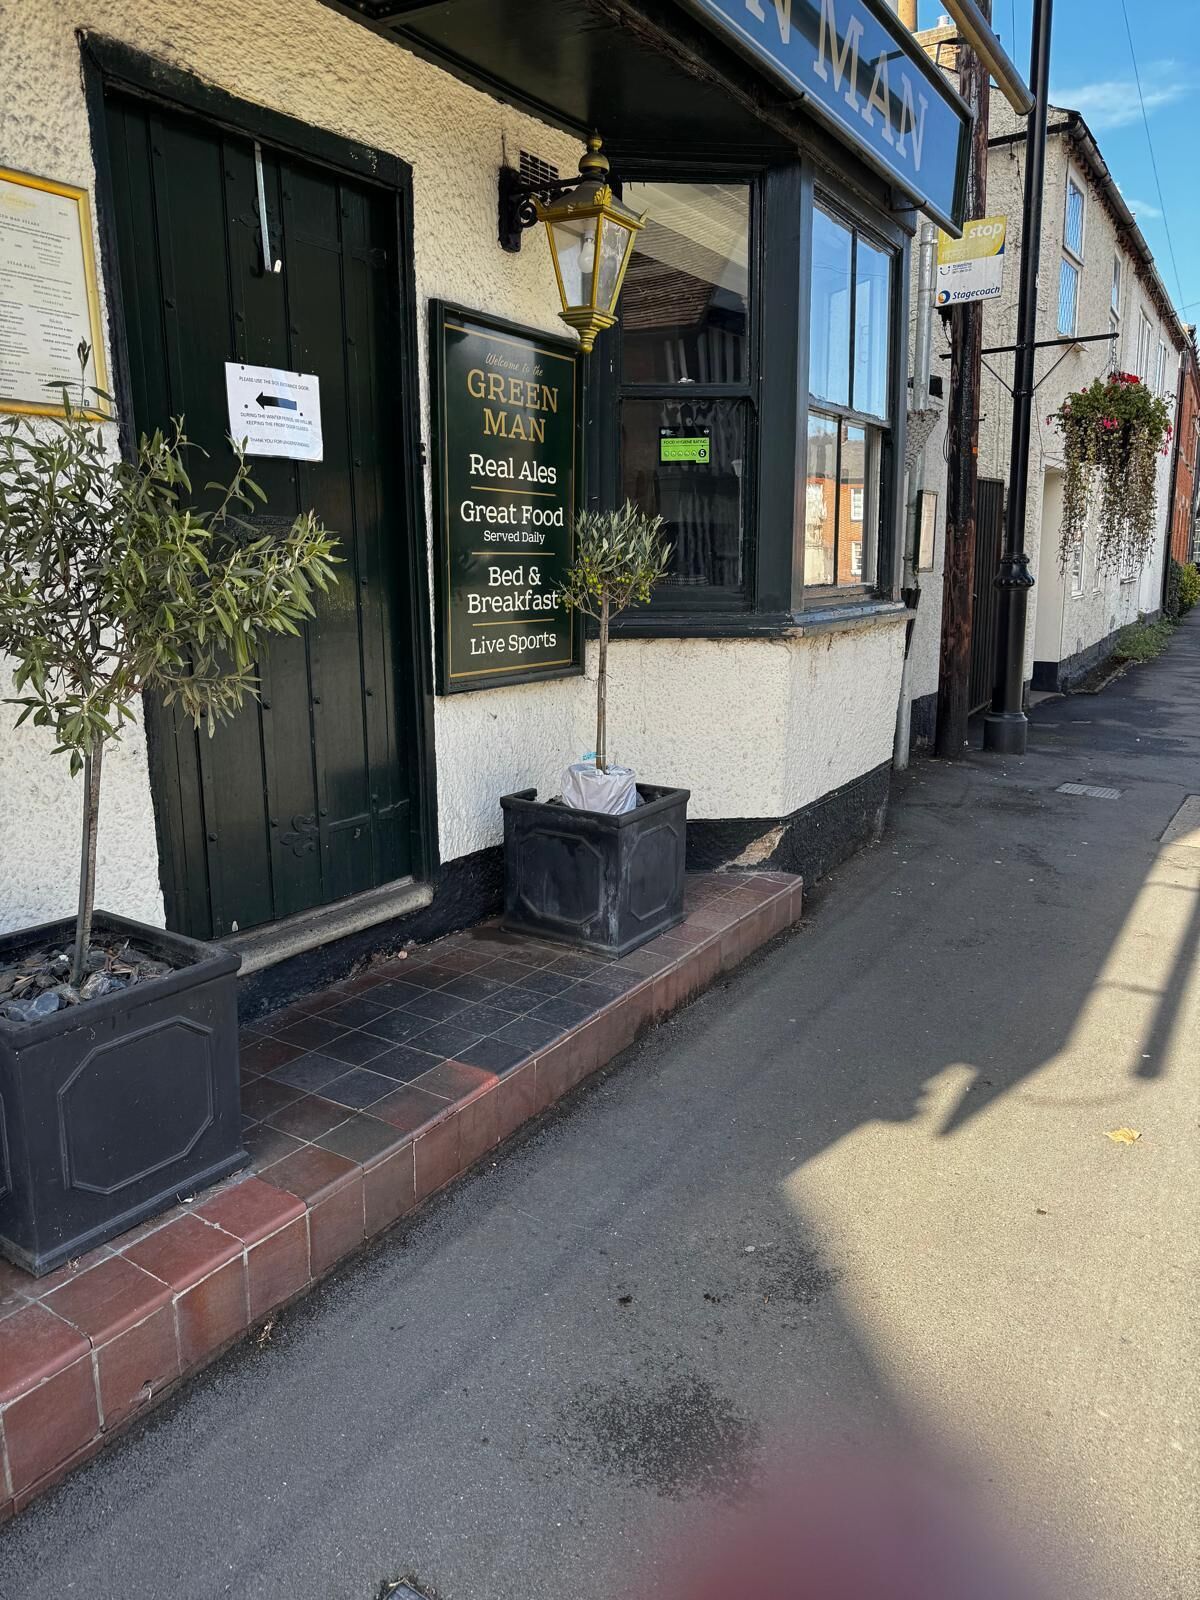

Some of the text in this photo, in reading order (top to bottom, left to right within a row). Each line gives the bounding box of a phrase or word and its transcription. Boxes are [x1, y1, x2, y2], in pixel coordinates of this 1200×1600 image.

[813, 0, 929, 172] MAN
[968, 222, 1004, 239] stop
[952, 286, 1000, 300] Stagecoach
[485, 352, 544, 377] Welcome to the
[467, 369, 558, 413] GREEN
[484, 408, 546, 443] MAN
[469, 454, 557, 484] Real Ales
[461, 501, 564, 527] Great Food
[484, 530, 546, 545] Served Daily
[488, 566, 541, 587] Bed &
[467, 590, 559, 614] Breakfast
[470, 631, 557, 655] Live Sports
